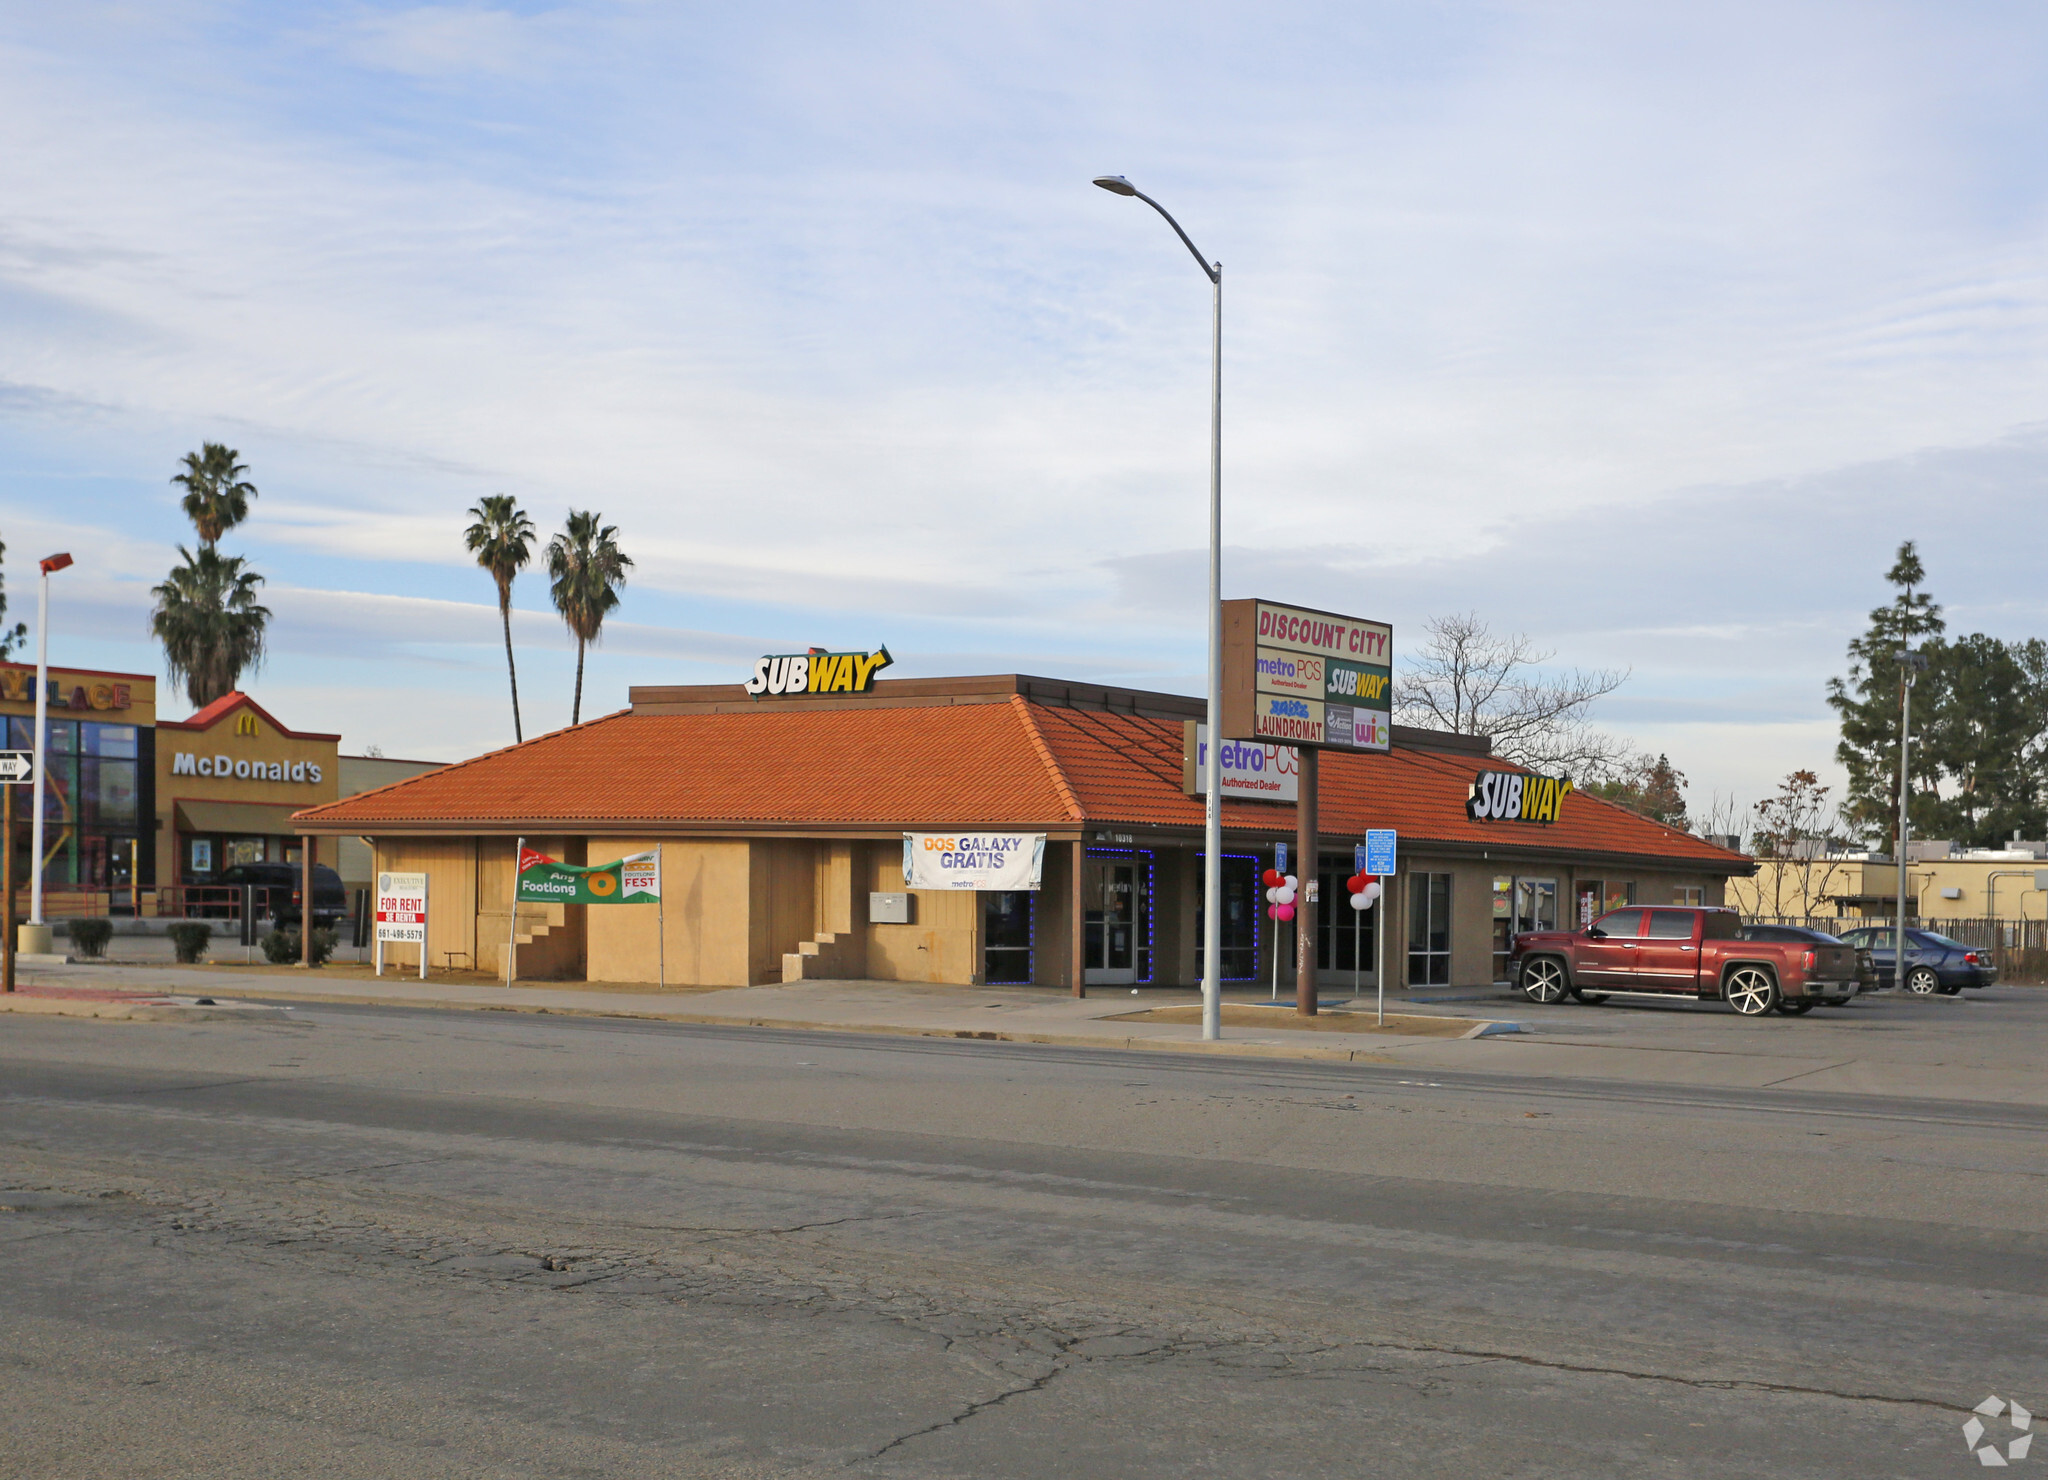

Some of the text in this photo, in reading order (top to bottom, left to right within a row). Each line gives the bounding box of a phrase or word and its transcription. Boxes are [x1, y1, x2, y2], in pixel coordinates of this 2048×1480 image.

[1259, 610, 1387, 657] DISCOUNT CITY
[744, 650, 887, 695] SUBWAY
[1327, 668, 1389, 700] SUBWAY
[1256, 714, 1322, 741] LAUNDROMAT
[2, 761, 17, 773] WAY
[173, 752, 322, 783] McDonald's
[1222, 777, 1281, 792] Authorized Dealer
[1473, 772, 1574, 821] SUBWAY
[924, 837, 1022, 852] DOS GALAXY
[940, 852, 1005, 869] GRATIS
[550, 872, 575, 883] Any
[624, 877, 656, 888] FEST
[522, 880, 577, 896] Footlong
[380, 897, 422, 912] FOR RENT
[385, 912, 416, 923] SE RENTA
